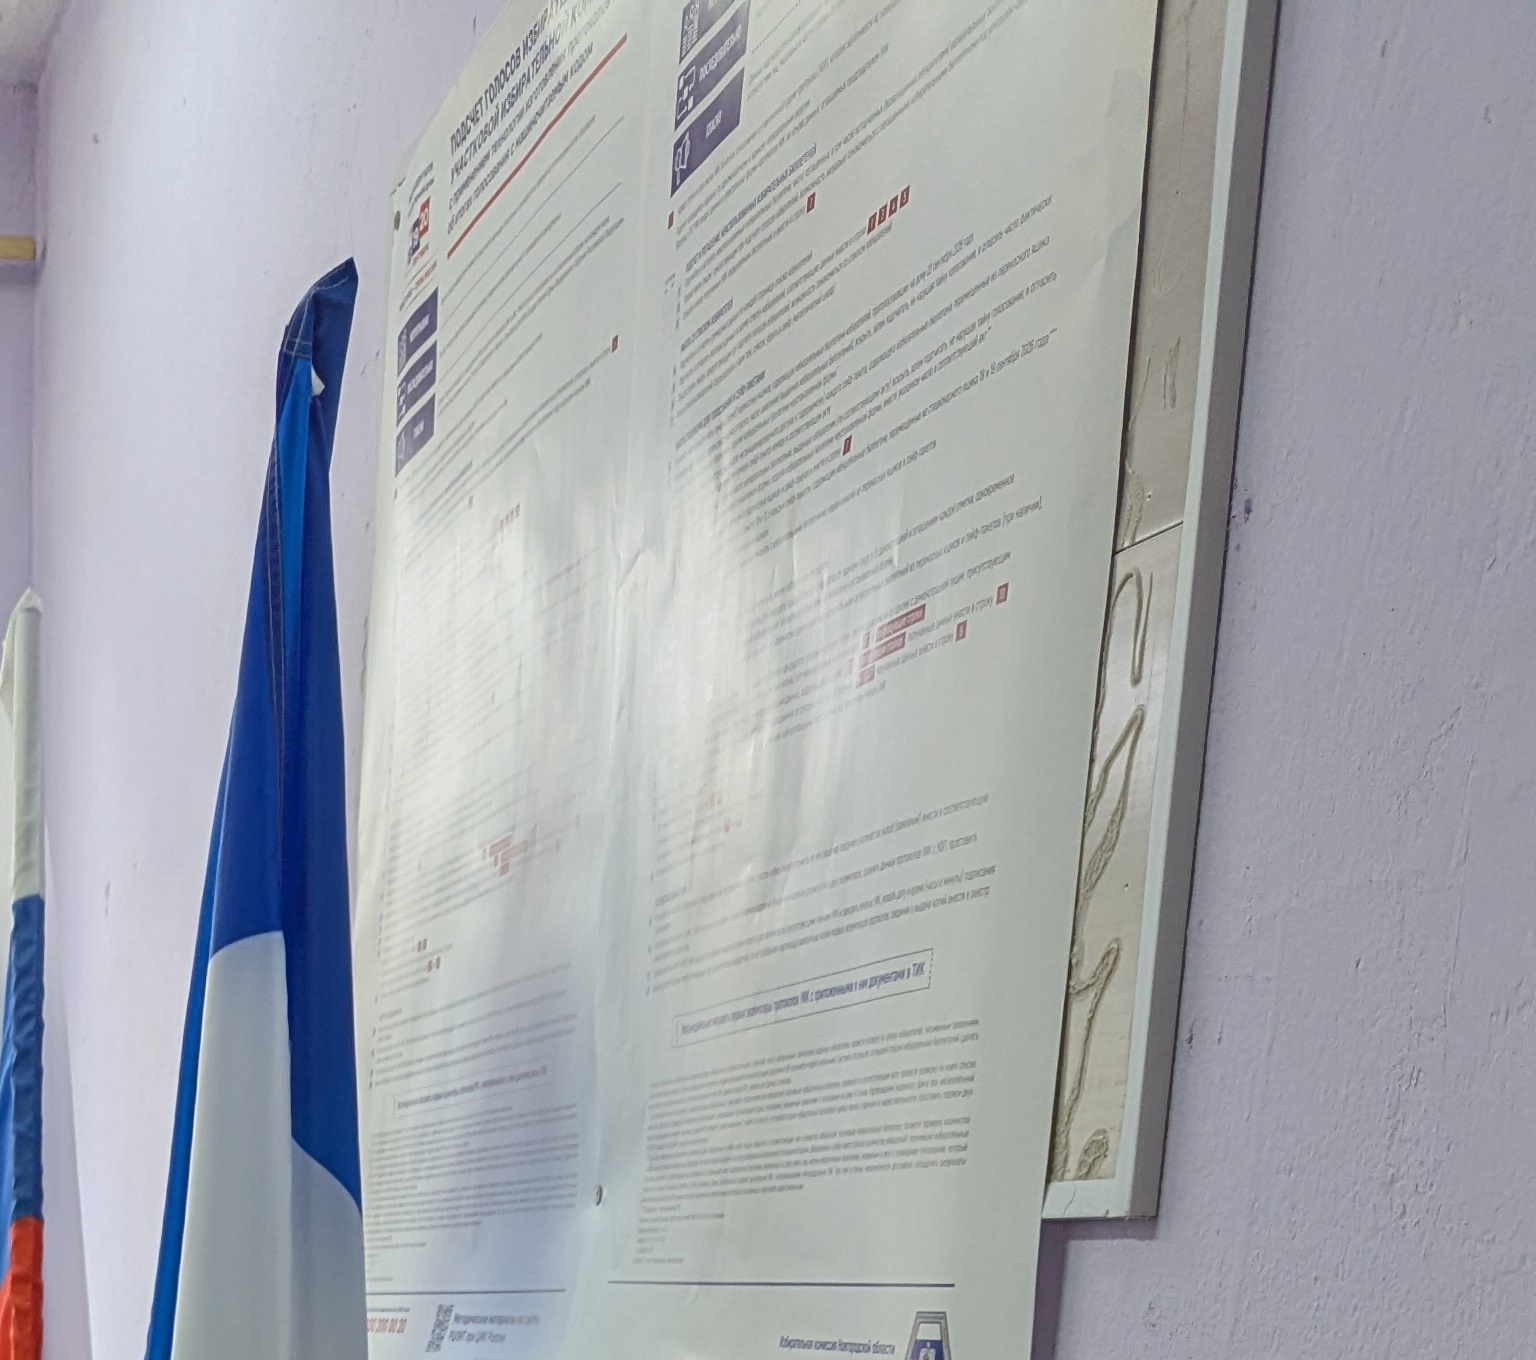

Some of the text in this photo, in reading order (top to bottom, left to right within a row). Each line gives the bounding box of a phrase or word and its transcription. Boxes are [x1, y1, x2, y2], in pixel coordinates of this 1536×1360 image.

[450, 96, 484, 156] ПОДСЧЕТ
[484, 46, 521, 111] ГОЛОСОВ
[450, 102, 500, 184] УЧАСТКОВОЙ
[912, 961, 925, 976] ТИК
